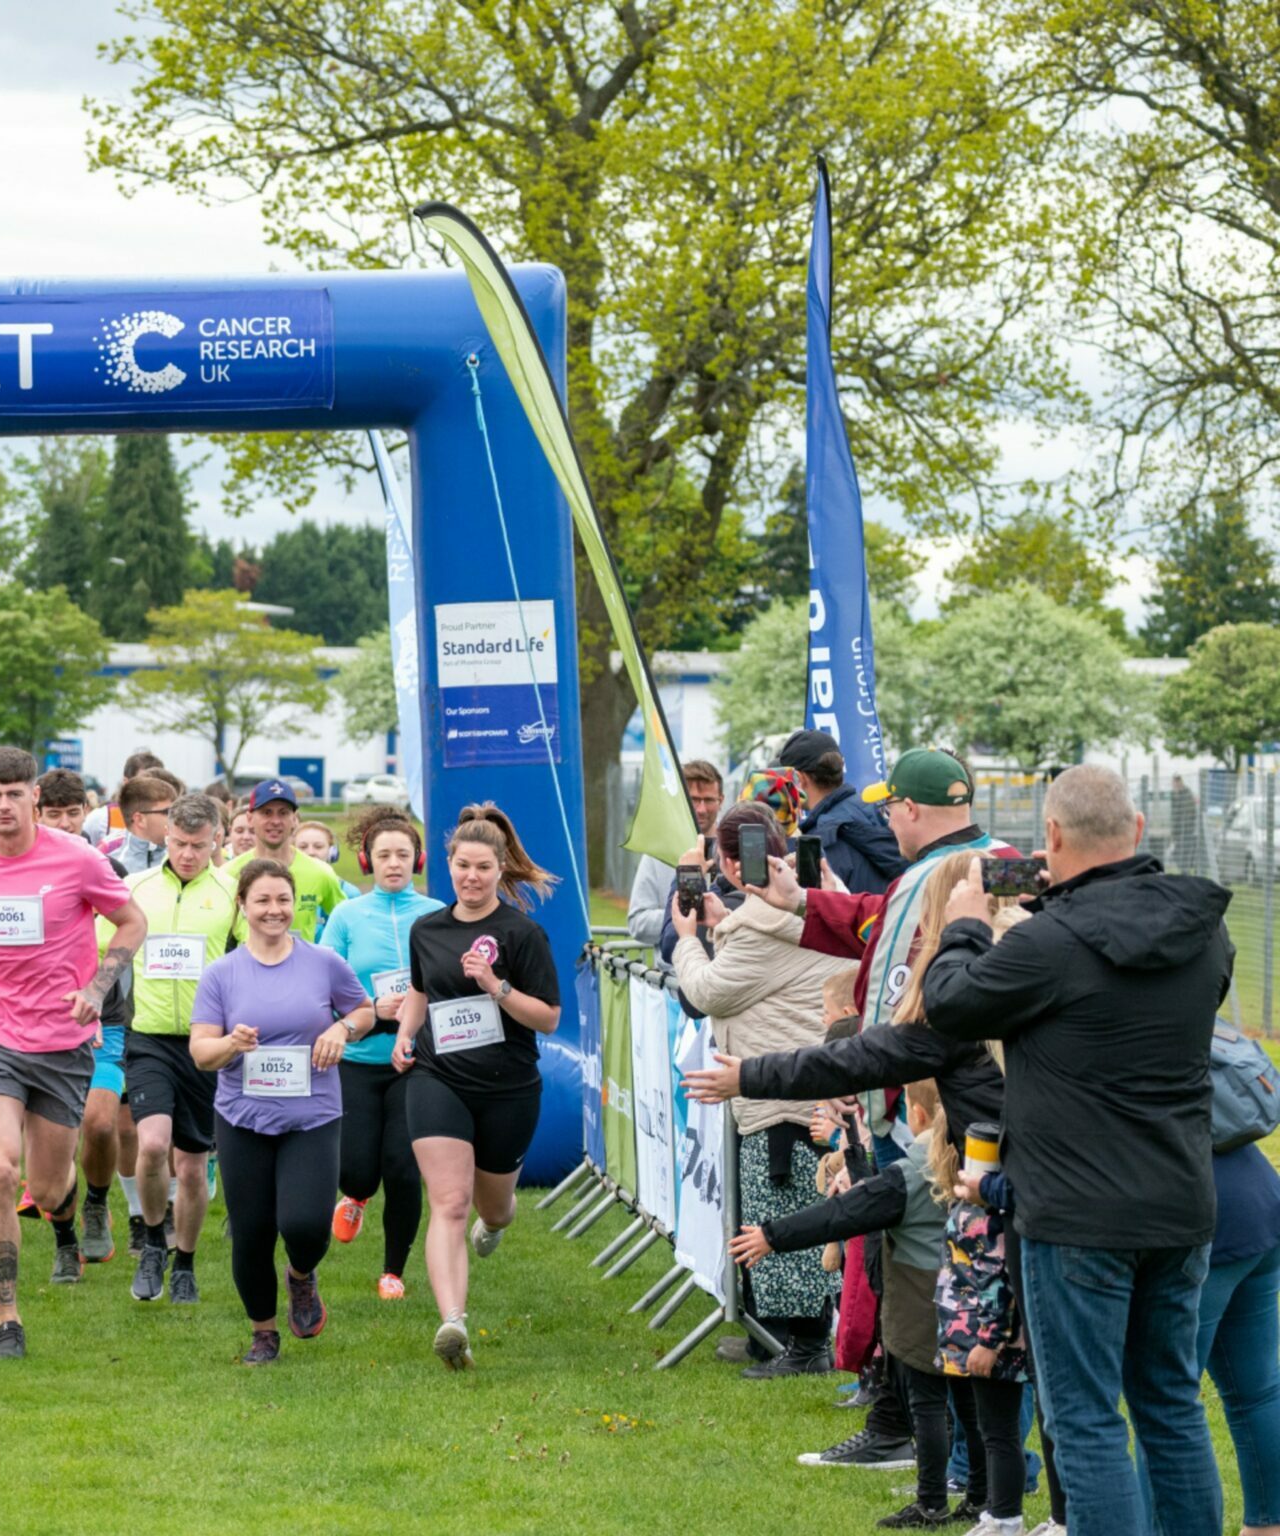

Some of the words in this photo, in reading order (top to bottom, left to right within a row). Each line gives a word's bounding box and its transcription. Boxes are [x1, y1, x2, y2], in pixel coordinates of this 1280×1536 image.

[198, 316, 292, 337] CANCER
[200, 338, 316, 360] RESEARCH
[200, 364, 231, 383] UK
[441, 623, 463, 632] Proud
[464, 621, 496, 631] Partner
[442, 638, 512, 656] Standard
[516, 637, 544, 652] Lfe
[159, 948, 191, 959] 10048
[449, 1012, 482, 1027] 10139
[260, 1062, 293, 1073] 10152
